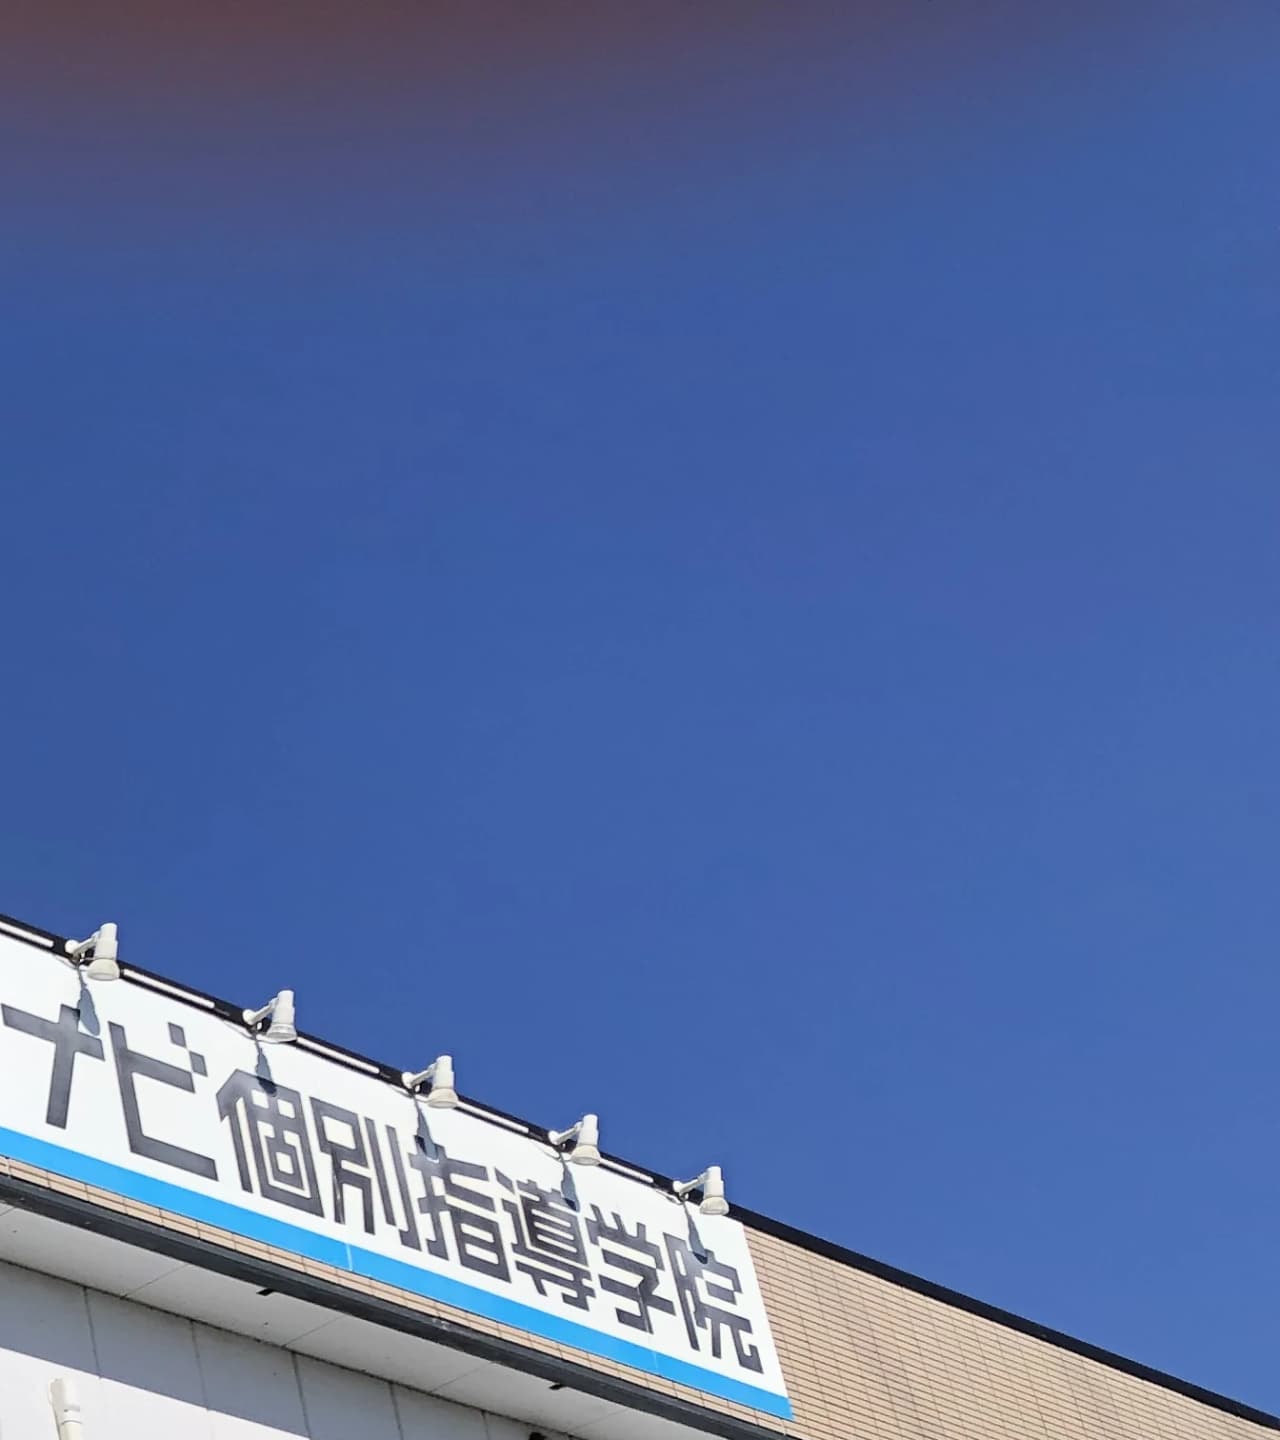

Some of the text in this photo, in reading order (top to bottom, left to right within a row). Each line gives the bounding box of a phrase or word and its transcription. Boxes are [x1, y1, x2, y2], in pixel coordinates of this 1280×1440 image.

[0, 1002, 763, 1375] ナビ個別指導学院
